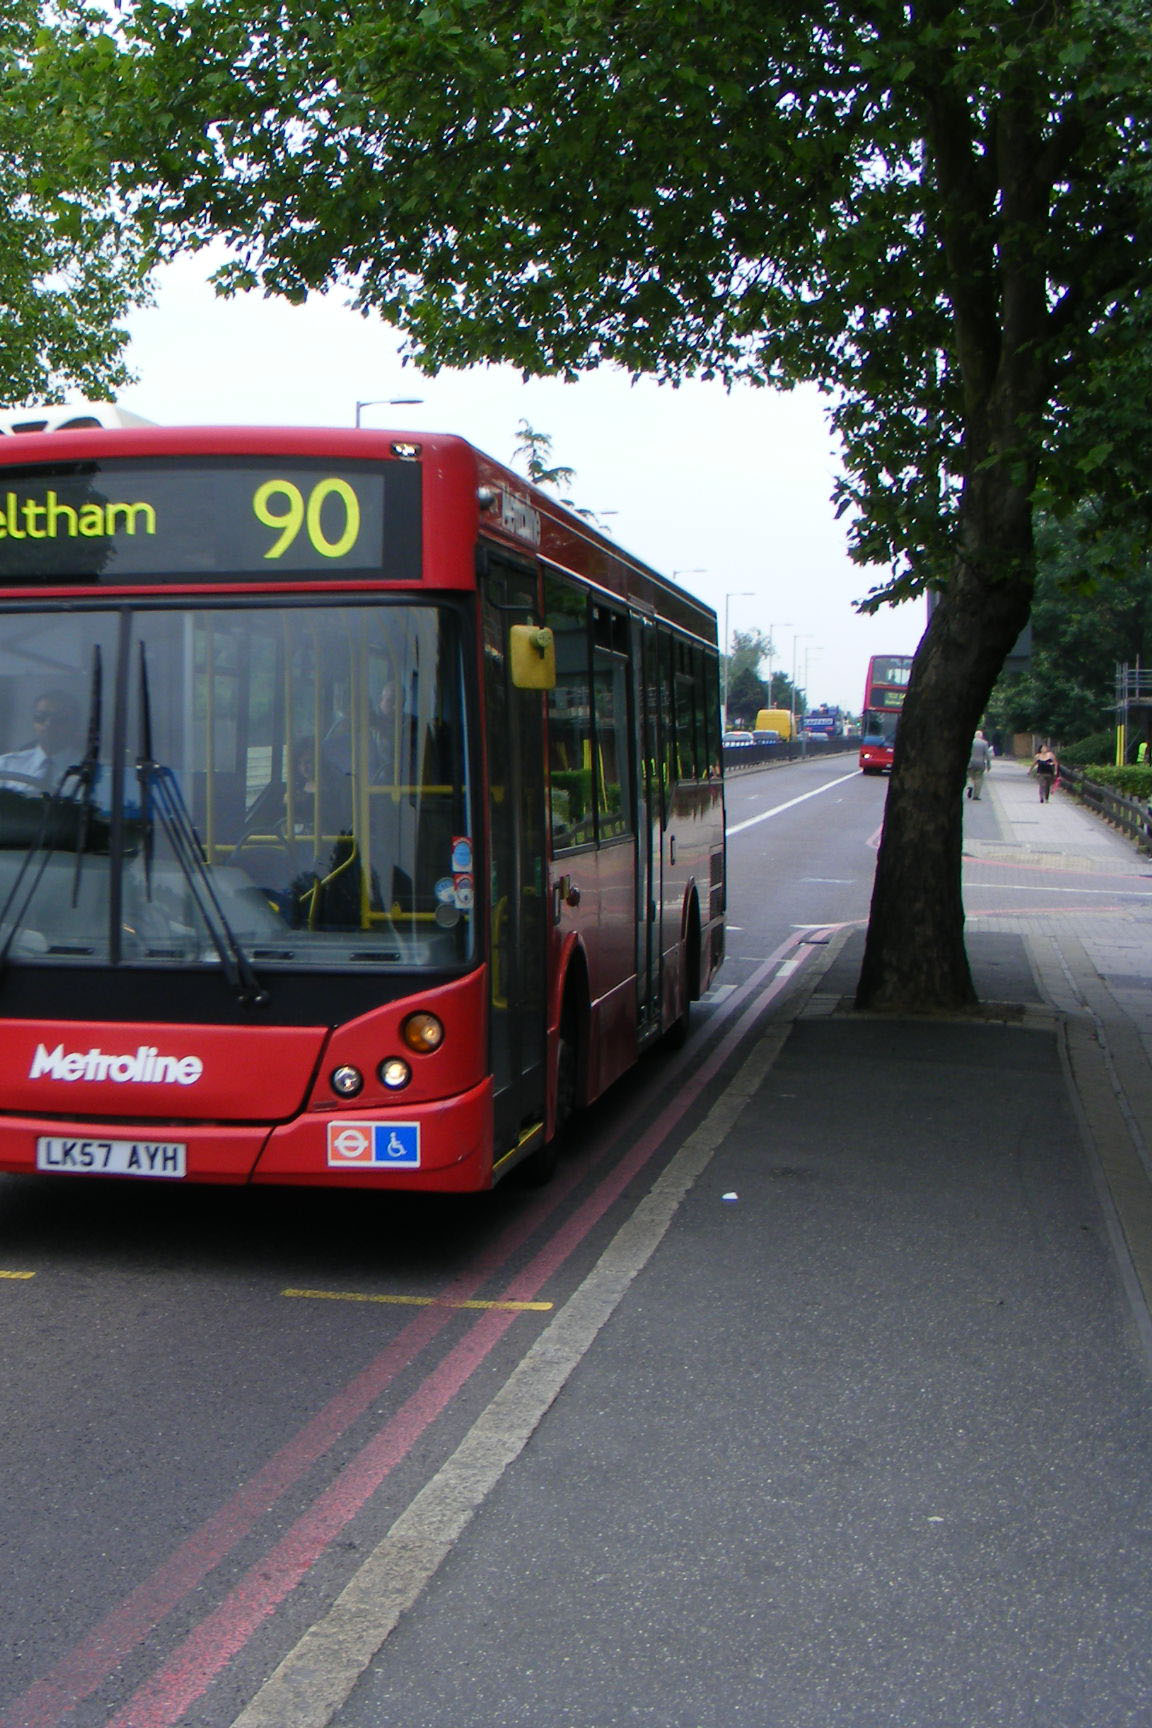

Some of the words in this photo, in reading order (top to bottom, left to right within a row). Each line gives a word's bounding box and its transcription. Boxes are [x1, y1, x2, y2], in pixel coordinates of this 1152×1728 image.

[253, 478, 360, 558] 90
[30, 1043, 203, 1085] Metroline
[45, 1140, 112, 1168] LK57
[128, 1144, 179, 1172] AYH
